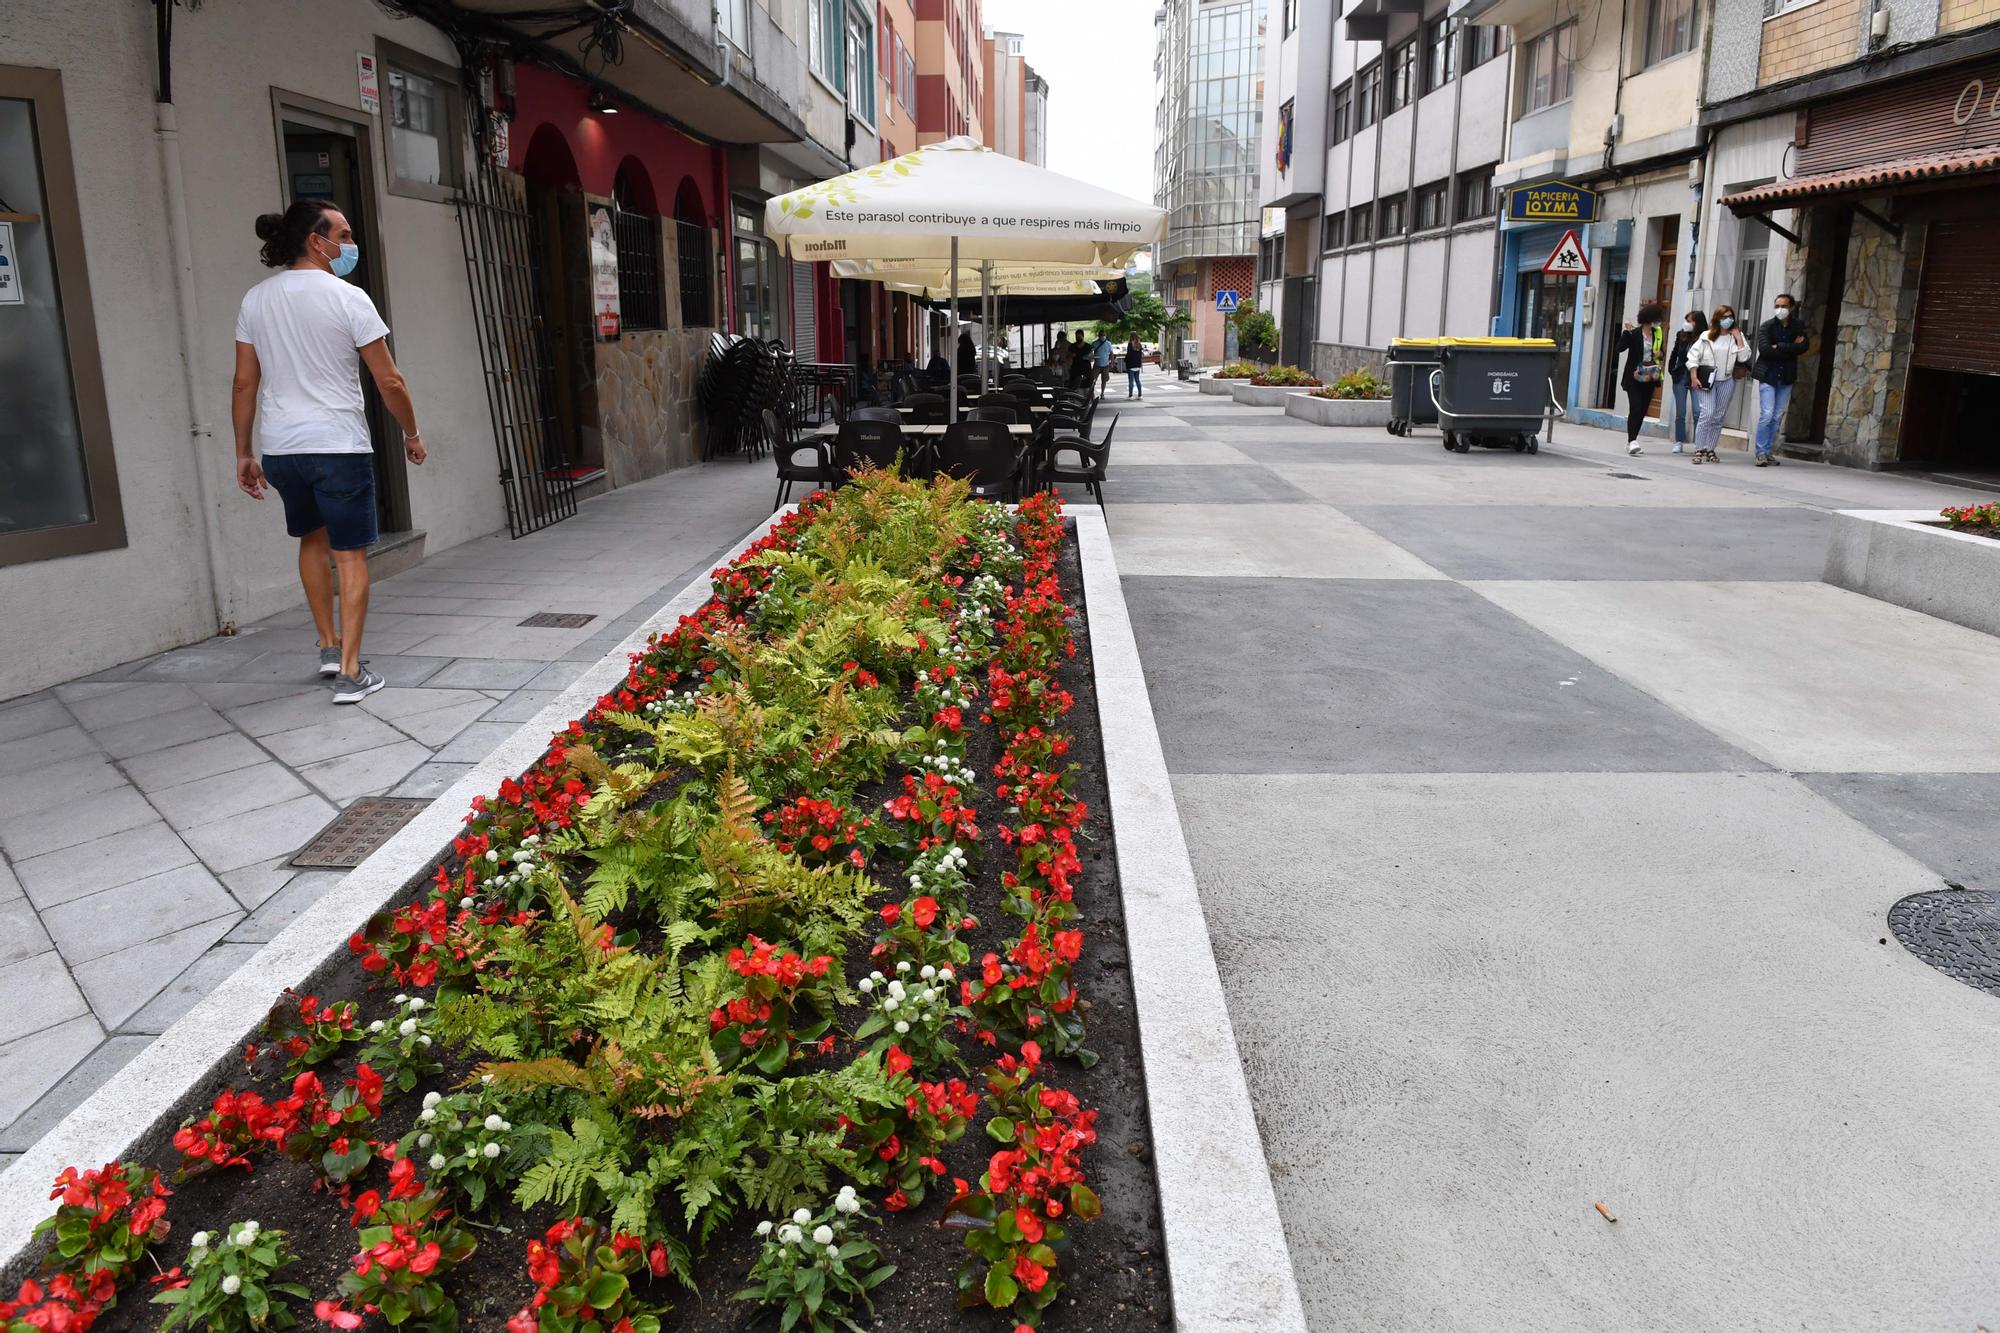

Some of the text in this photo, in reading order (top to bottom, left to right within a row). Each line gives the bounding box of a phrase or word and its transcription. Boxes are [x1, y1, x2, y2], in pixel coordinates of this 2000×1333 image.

[1528, 191, 1580, 201] TAPICERIA
[1526, 201, 1578, 216] LOYMA
[826, 210, 1142, 234] Este parasol contribuye a que respires más limpio
